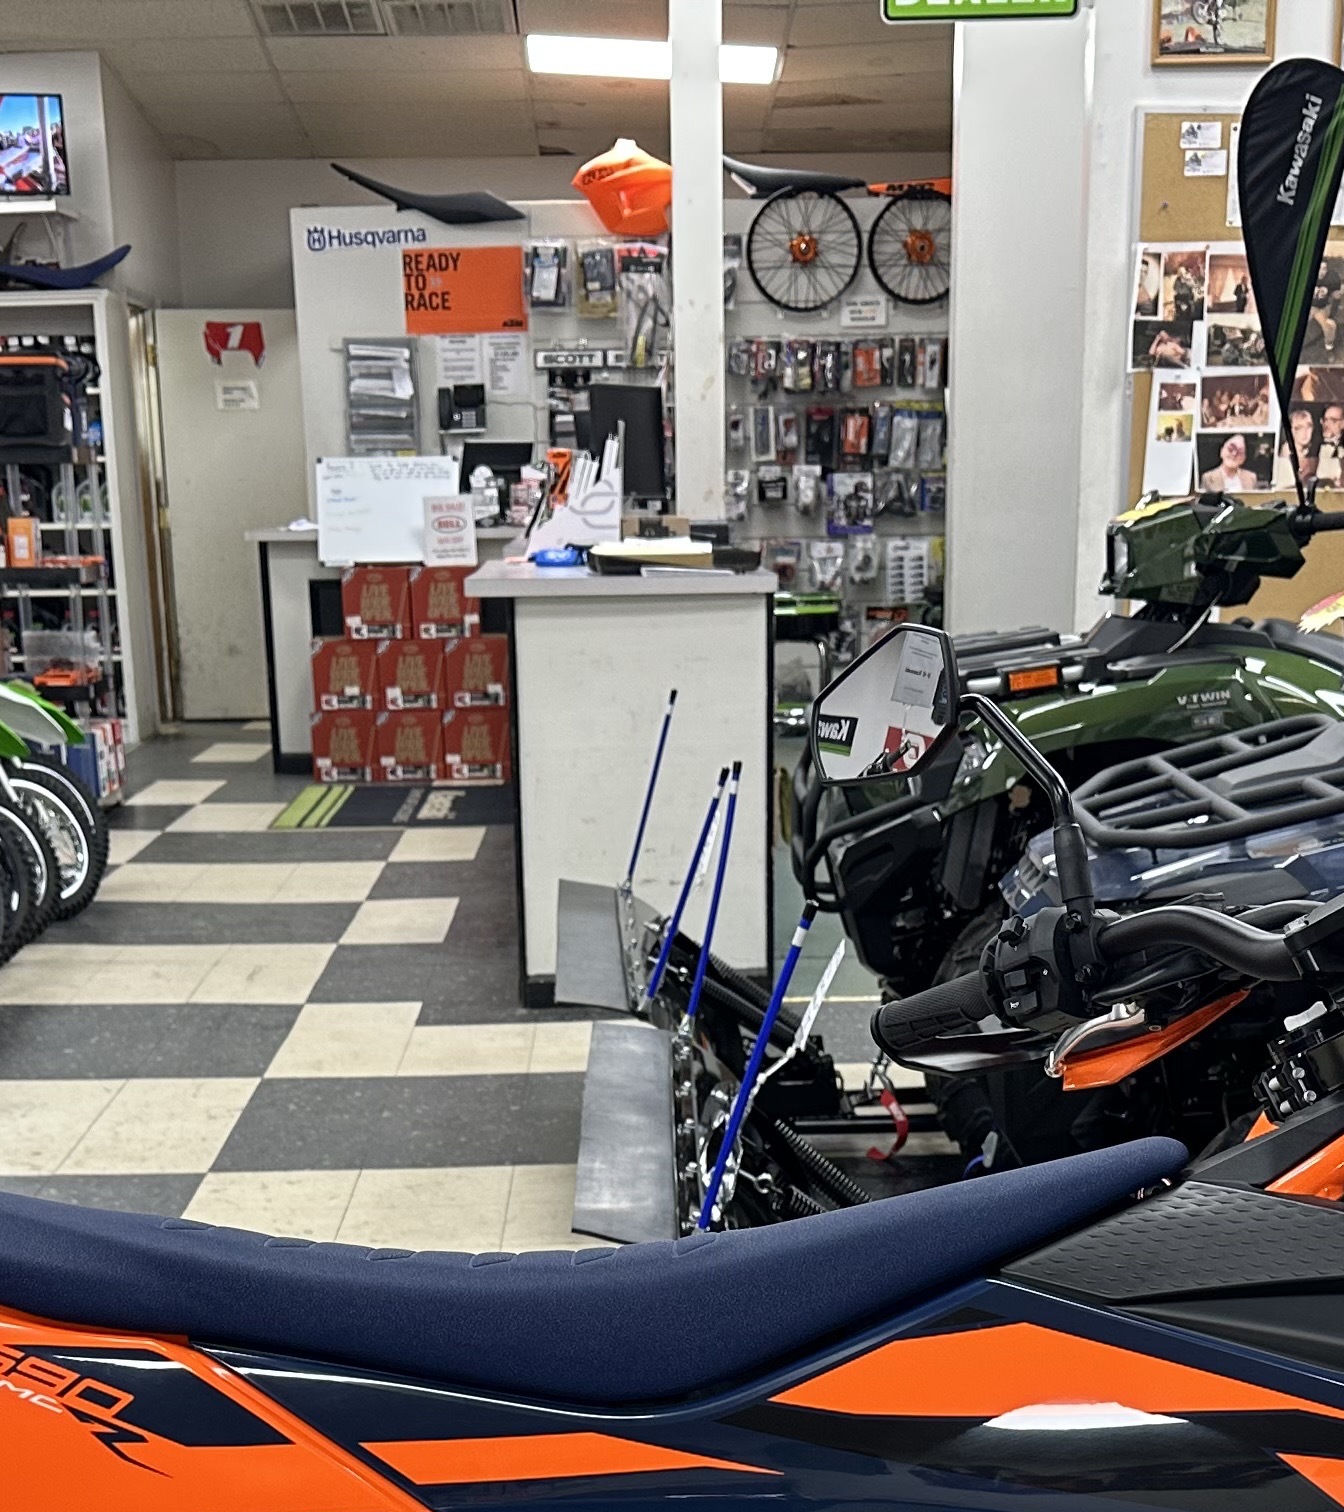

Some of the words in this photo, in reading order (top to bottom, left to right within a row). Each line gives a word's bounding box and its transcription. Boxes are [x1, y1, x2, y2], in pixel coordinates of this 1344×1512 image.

[1276, 93, 1323, 206] Kawasaki
[328, 227, 428, 250] Husqvarna
[403, 252, 462, 272] READY
[404, 273, 427, 292] TO
[405, 292, 452, 311] RACE
